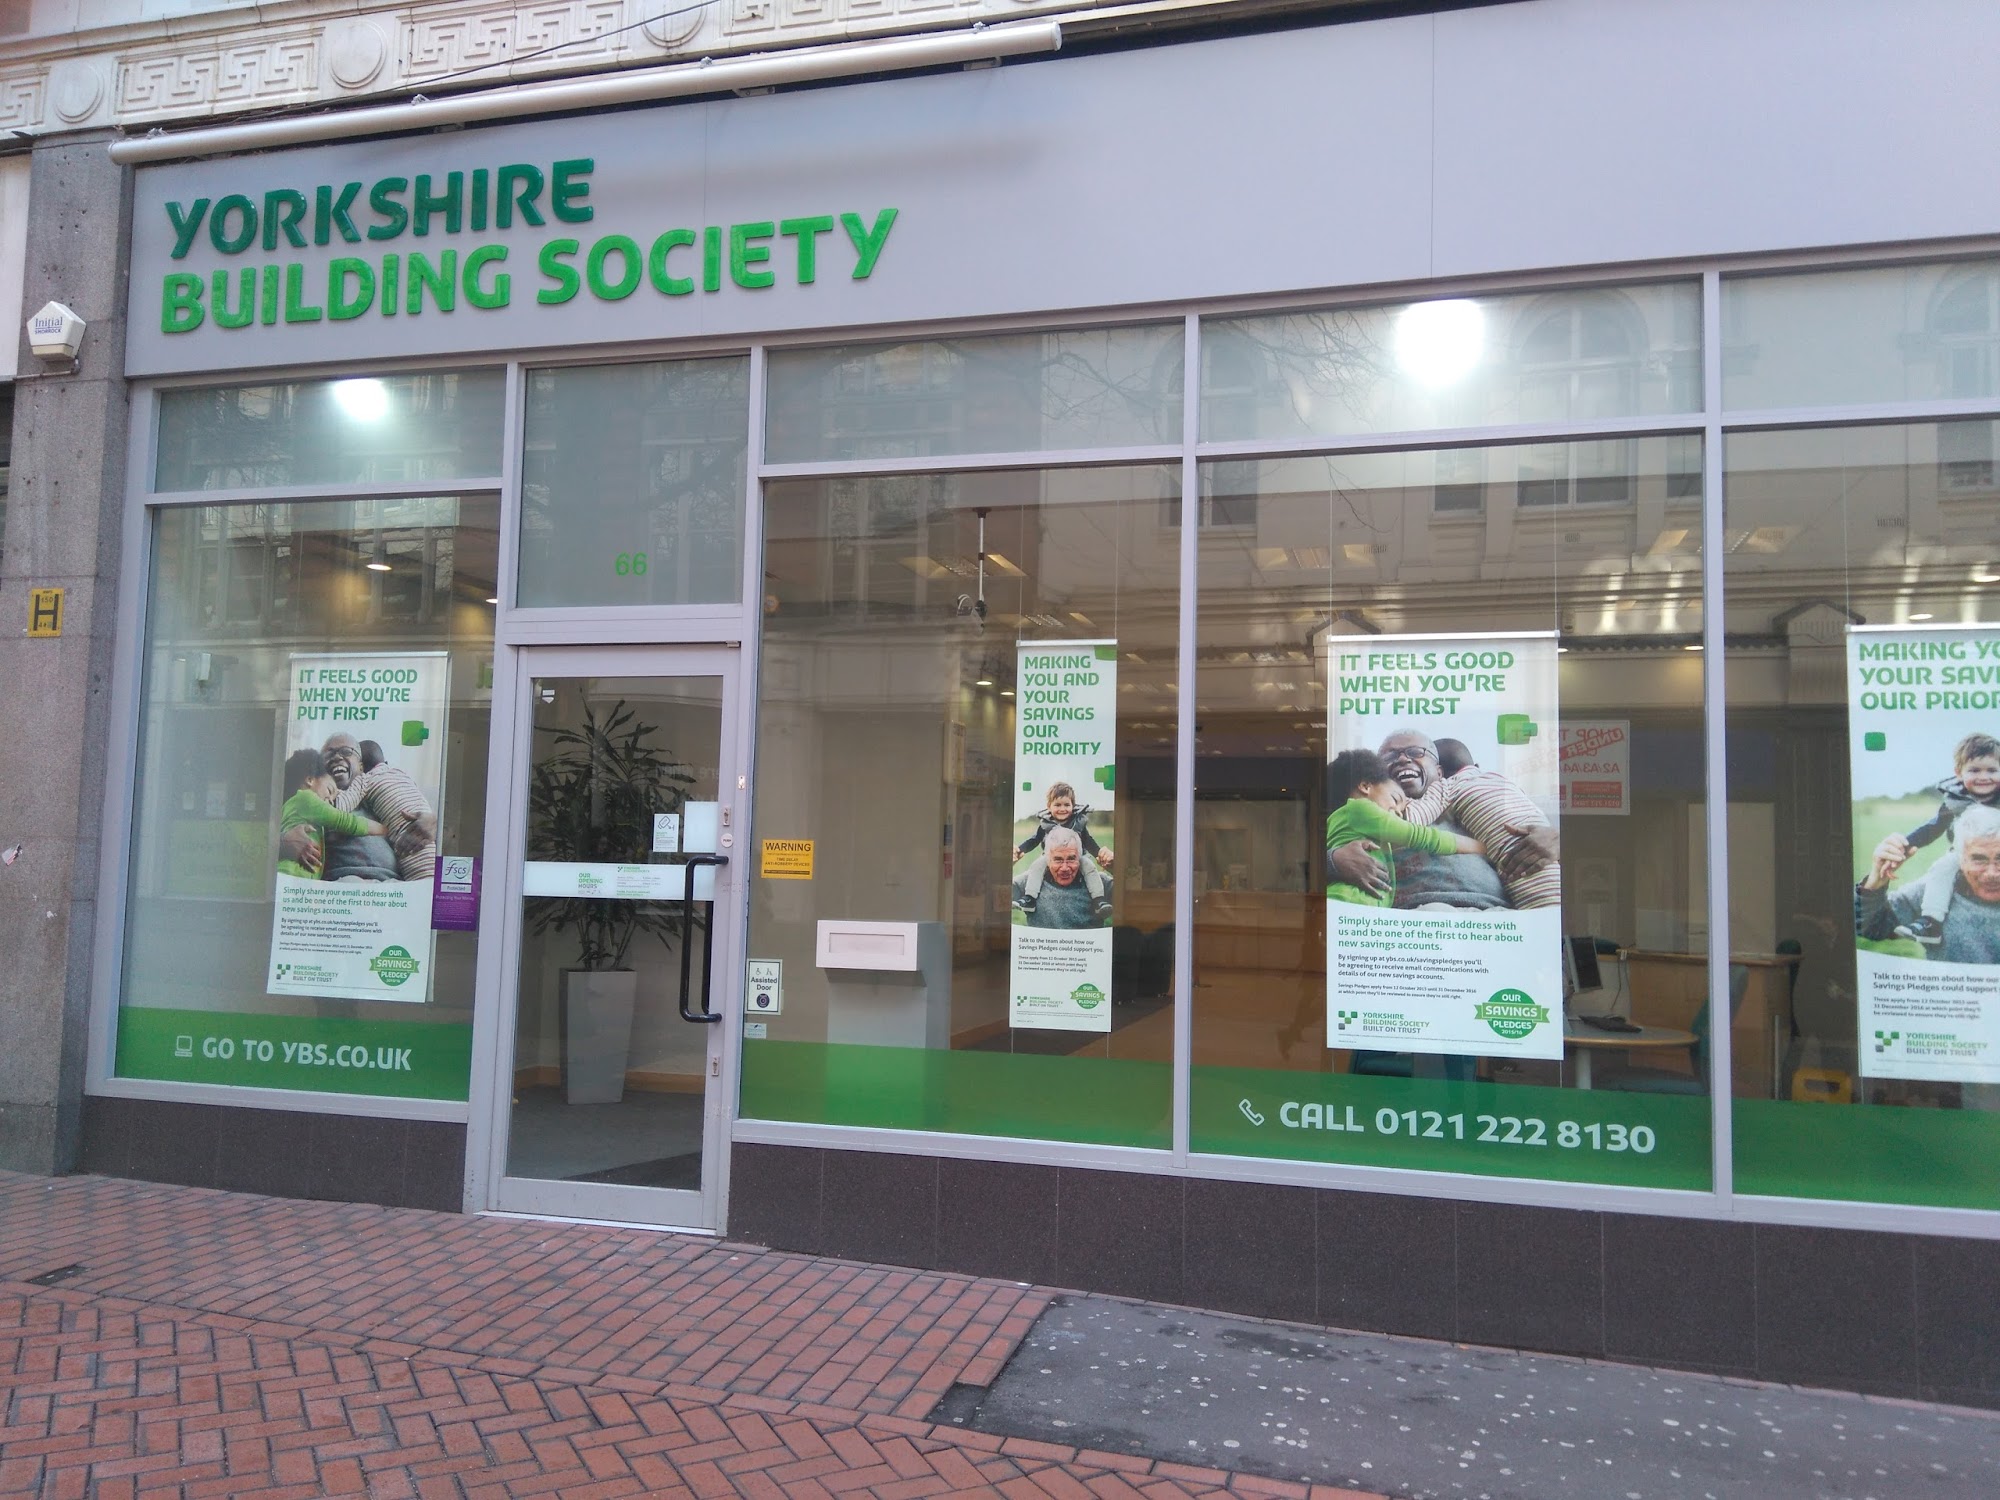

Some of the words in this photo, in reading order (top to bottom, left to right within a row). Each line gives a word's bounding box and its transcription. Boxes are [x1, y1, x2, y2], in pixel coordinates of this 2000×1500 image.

[165, 158, 595, 259] YORKSHIRE
[161, 244, 511, 334] BUILDING
[537, 208, 899, 304] SOCIETY
[35, 316, 63, 328] Initial
[615, 551, 648, 577] 66
[33, 593, 59, 631] H
[1859, 641, 1966, 661] MAKING
[1024, 655, 1091, 669] MAKING
[1340, 654, 1361, 671] IT
[1368, 653, 1437, 671] FEELS
[1445, 651, 1514, 670] GOOD
[299, 669, 315, 683] IT
[318, 669, 366, 683] FEELS
[371, 669, 418, 684] GOOD
[1024, 673, 1058, 686] YOU
[1063, 672, 1100, 686] AND
[1859, 666, 1933, 685] YOUR
[1340, 675, 1410, 693] WHEN
[1417, 673, 1506, 693] YOU'RE
[299, 687, 347, 702] WHEN
[352, 686, 411, 702] YOU'RE
[1023, 690, 1070, 704] YOUR
[1860, 691, 1917, 710] OUR
[1340, 697, 1386, 715] PUT
[1393, 697, 1461, 715] FIRST
[297, 706, 329, 721] PUT
[333, 706, 379, 721] FIRST
[1023, 707, 1095, 721] SAVINGS
[1023, 724, 1059, 738] OUR
[1022, 742, 1101, 755] PRIORITY
[765, 842, 811, 852] WARNING
[283, 886, 306, 896] Simply
[388, 900, 408, 908] about
[297, 906, 321, 916] savings
[1338, 916, 1371, 927] Simply
[1373, 917, 1399, 926] share
[1401, 920, 1423, 929] your
[1424, 919, 1452, 928] email
[1454, 920, 1492, 929] address
[1494, 921, 1517, 930] with
[1350, 928, 1368, 937] and
[1370, 928, 1382, 937] be
[1384, 930, 1402, 938] one
[1404, 930, 1415, 938] of
[1417, 930, 1432, 938] the
[1435, 931, 1456, 939] first
[1458, 932, 1468, 940] to
[1470, 932, 1492, 940] hear
[1494, 932, 1524, 942] about
[1360, 940, 1395, 951] savings
[1397, 941, 1443, 950] accounts.
[376, 959, 412, 969] SAVINGS
[1338, 953, 1346, 961] By
[1347, 954, 1369, 962] signing
[1386, 956, 1463, 966] ybs.co.uk/savingspledges
[381, 971, 407, 979] PLEDGES
[750, 976, 778, 984] Assisted
[1392, 972, 1415, 980] savings
[1873, 972, 1890, 980] Talk
[1902, 973, 1917, 981] the
[1966, 975, 1984, 983] how
[1873, 982, 1905, 991] Savings
[1907, 982, 1940, 992] Pledges
[1941, 984, 1964, 992] could
[1965, 985, 1998, 994] support
[1501, 993, 1521, 1002] OUR
[1363, 1012, 1404, 1020] YORKSHIRE
[1485, 1005, 1538, 1018] SAVINGS
[1397, 1026, 1421, 1034] TRUST
[1399, 1020, 1430, 1028] SOCIETY
[1493, 1020, 1532, 1030] PLEDGES
[1906, 1032, 1957, 1040] YORKSHIRE
[1906, 1040, 1949, 1048] BUILDING
[1951, 1041, 1989, 1049] SOCIETY
[202, 1037, 235, 1060] GO
[243, 1039, 274, 1062] TO
[282, 1041, 412, 1071] YBS.CO.UK
[1906, 1047, 1931, 1055] BUILT
[1934, 1047, 1948, 1055] ON
[1949, 1048, 1978, 1056] TRUST
[1279, 1101, 1364, 1132] CALL
[1375, 1107, 1464, 1140] 0121
[1476, 1114, 1548, 1146] 222
[1557, 1120, 1656, 1154] 8130
